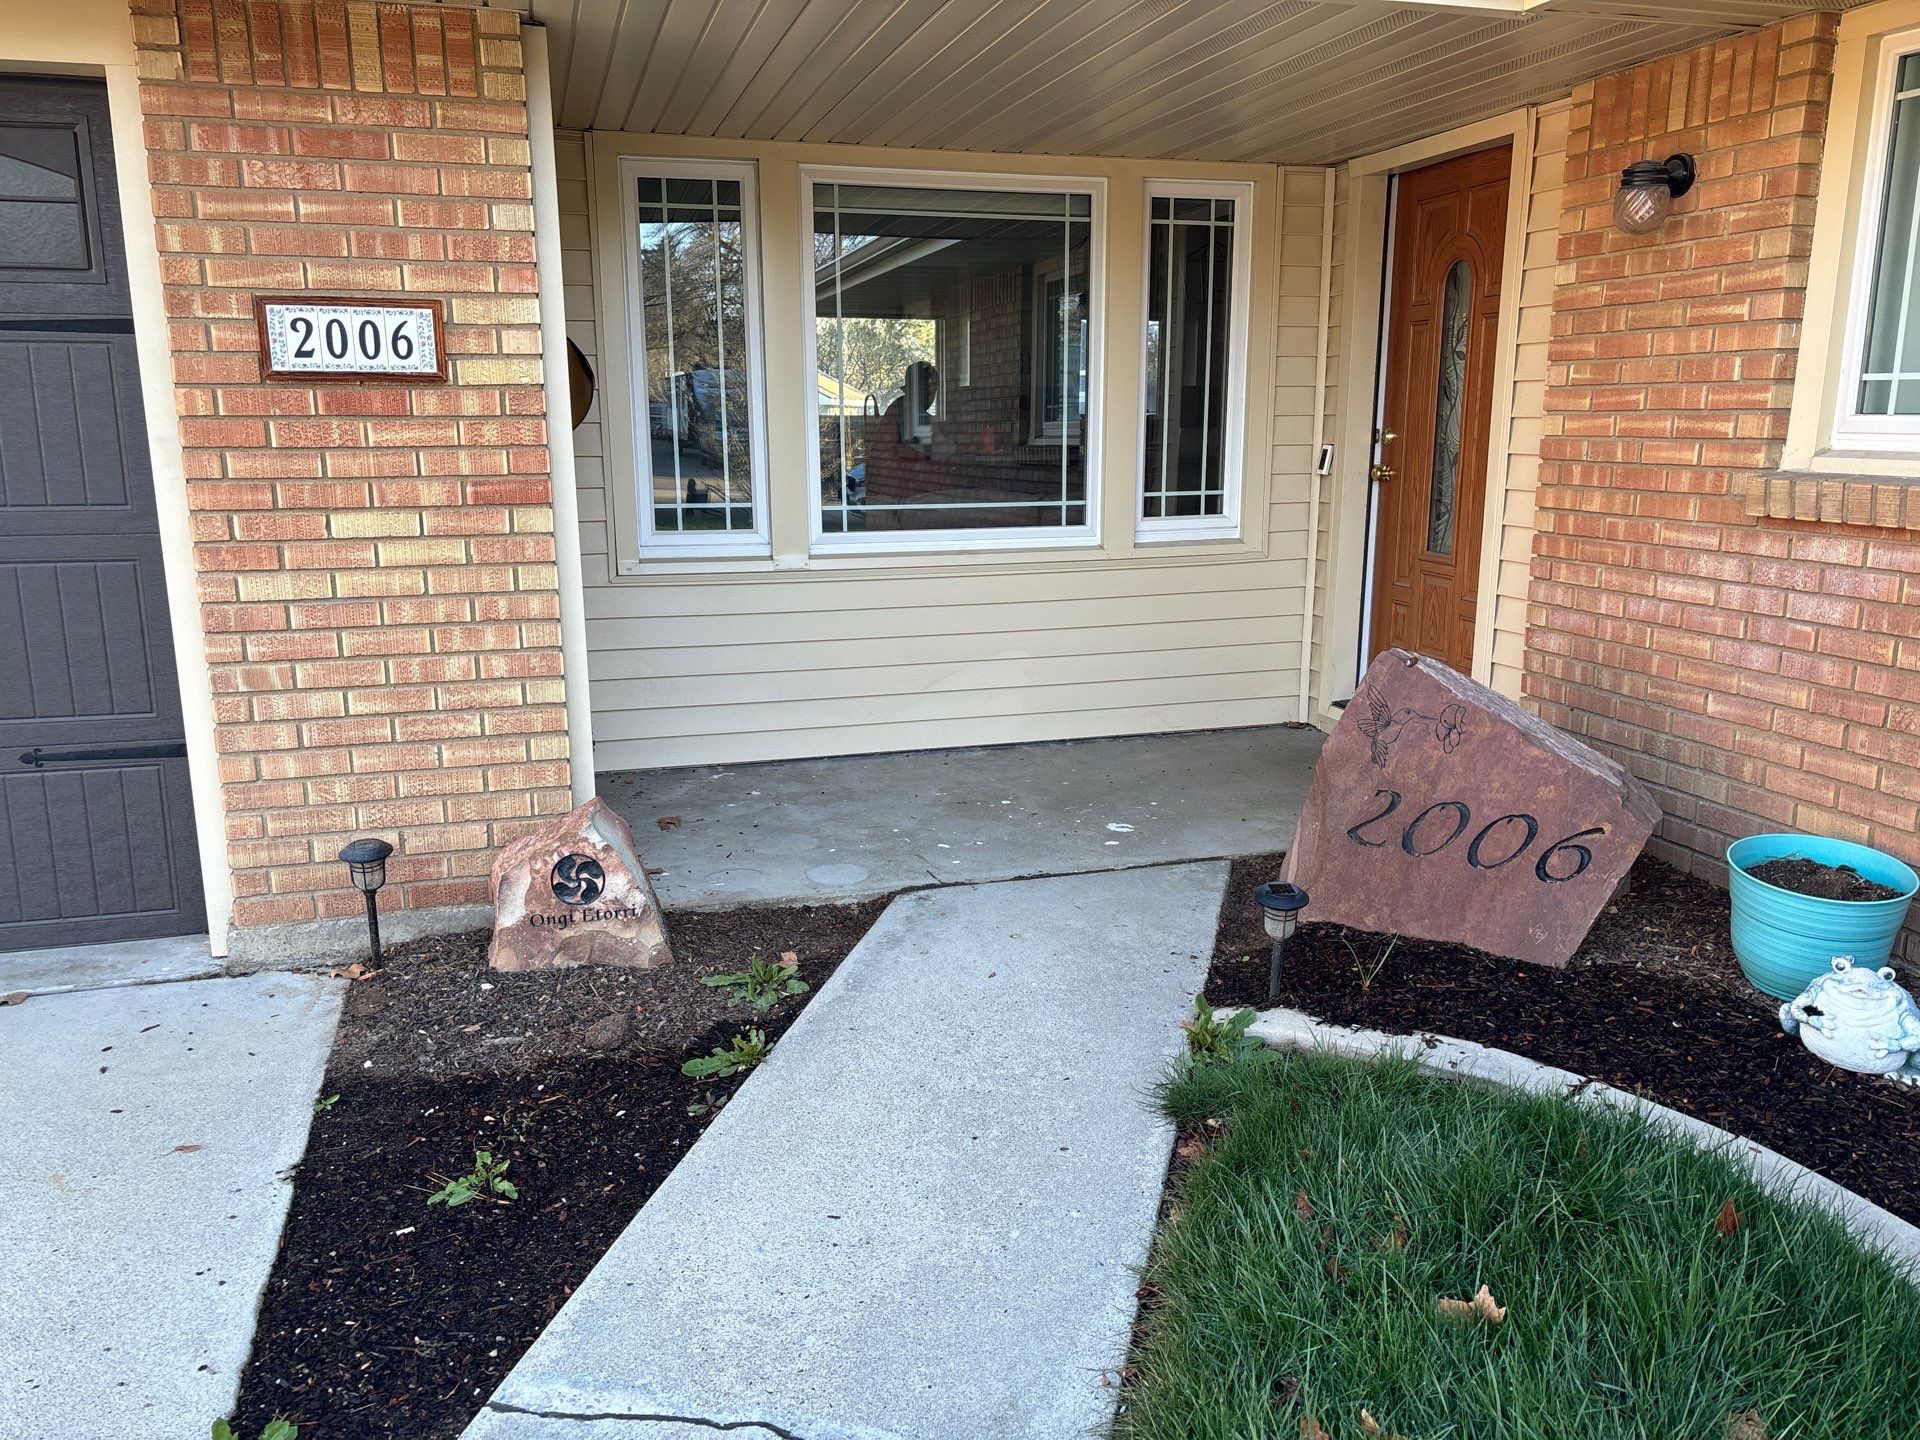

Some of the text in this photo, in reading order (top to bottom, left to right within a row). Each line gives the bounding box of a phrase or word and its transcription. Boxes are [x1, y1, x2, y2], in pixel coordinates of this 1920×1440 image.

[289, 317, 414, 360] 2006
[1346, 789, 1606, 883] 2006
[529, 903, 638, 931] Ongi Etorri
